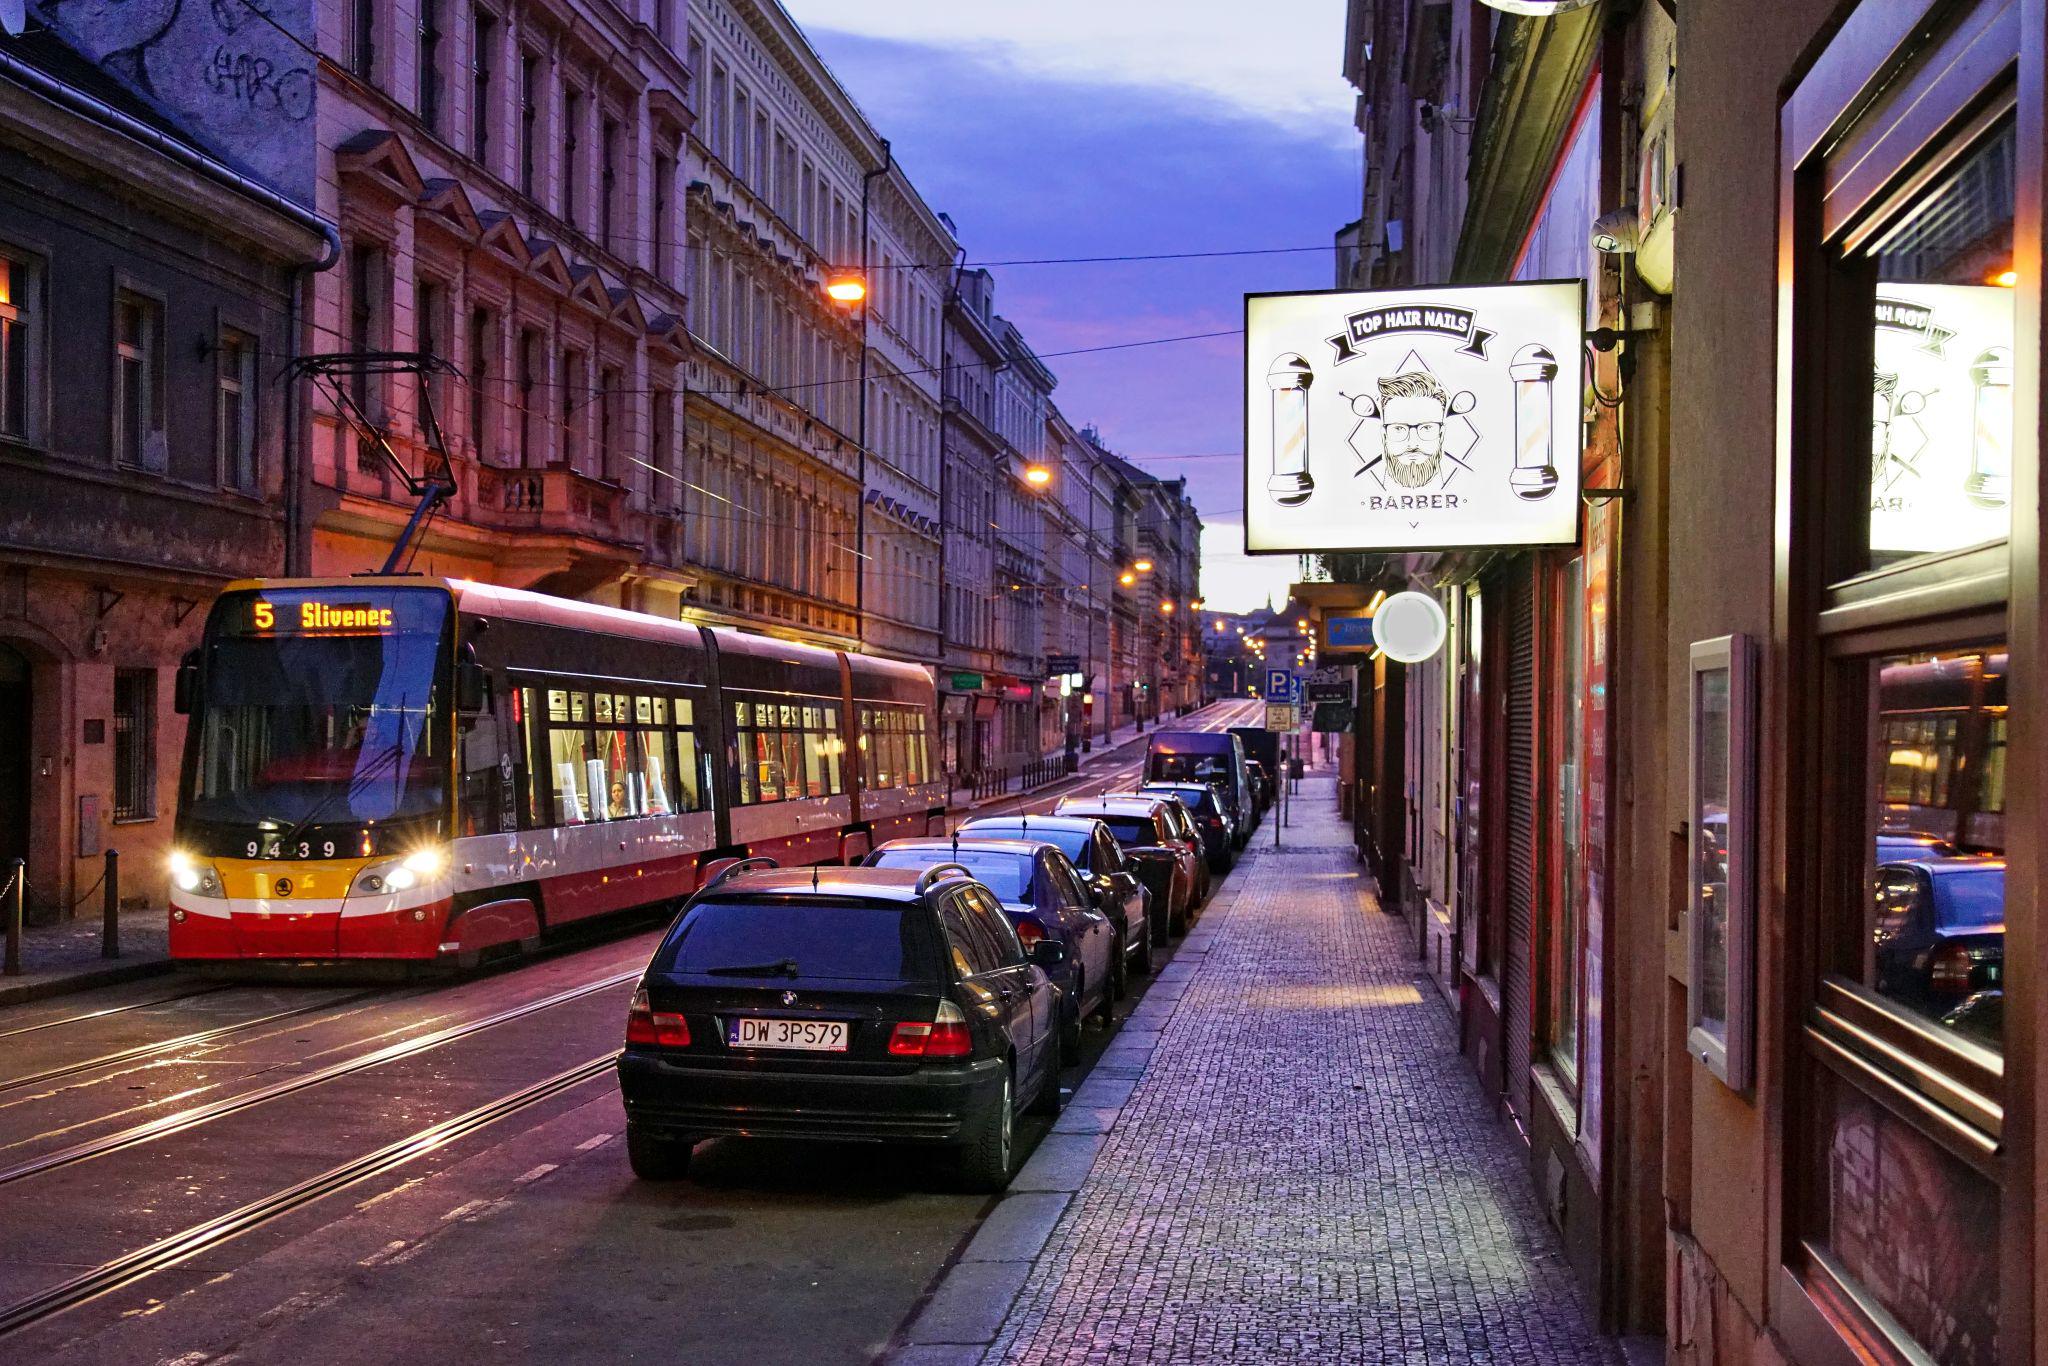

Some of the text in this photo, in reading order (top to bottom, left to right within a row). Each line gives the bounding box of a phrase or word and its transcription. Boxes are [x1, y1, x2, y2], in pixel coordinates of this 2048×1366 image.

[1353, 310, 1468, 335] TOP HAIR NAILS
[1369, 494, 1459, 510] BARBER
[255, 602, 392, 628] 5 Slivenec
[1271, 672, 1287, 694] P
[743, 1021, 843, 1045] DW 3PS79
